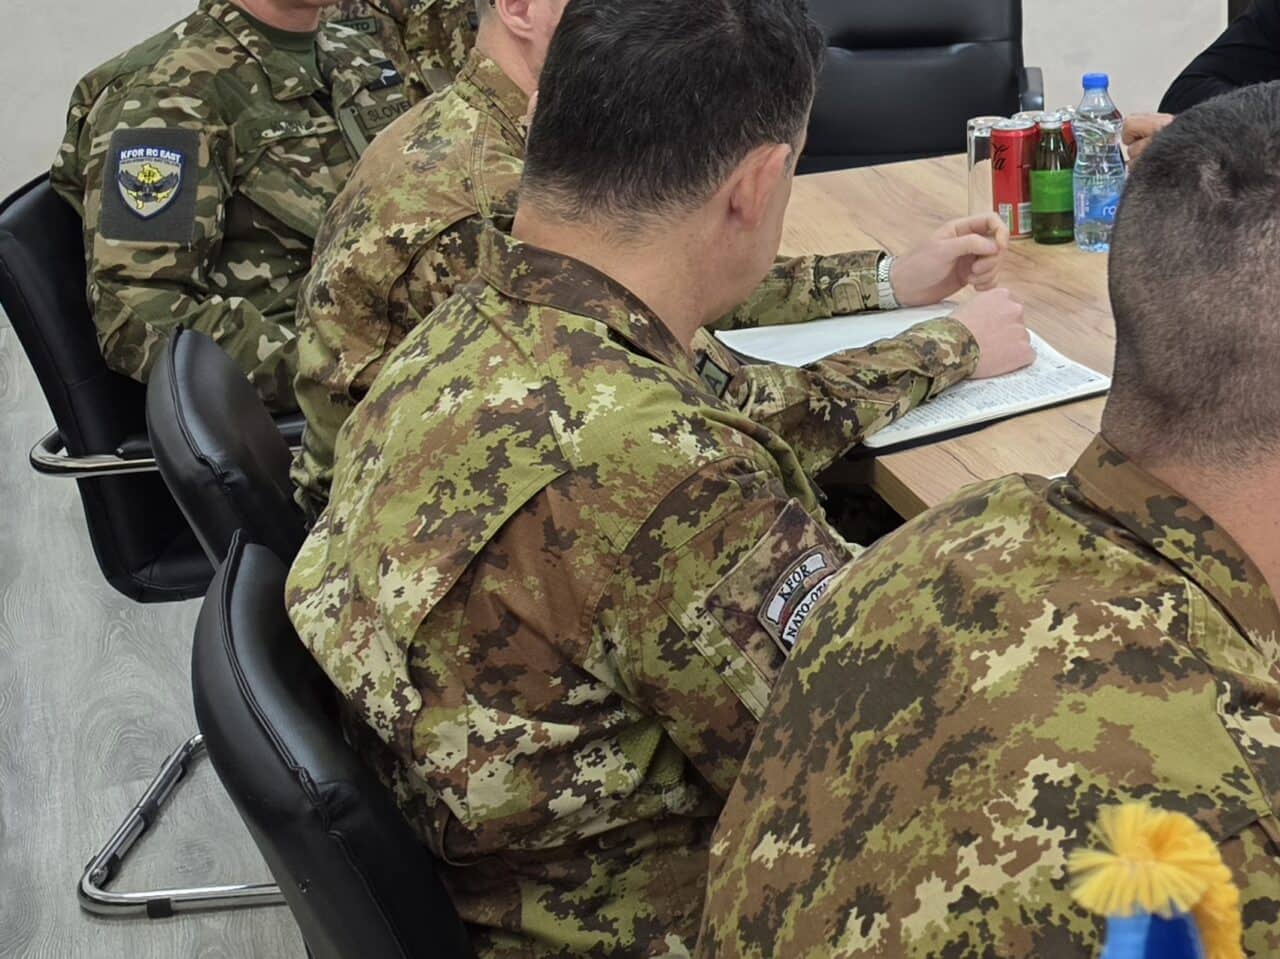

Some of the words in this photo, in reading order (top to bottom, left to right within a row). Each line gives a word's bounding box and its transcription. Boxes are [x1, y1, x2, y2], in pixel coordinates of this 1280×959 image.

[120, 149, 145, 160] KFOR
[160, 150, 181, 163] EAST
[778, 563, 811, 602] KFOR
